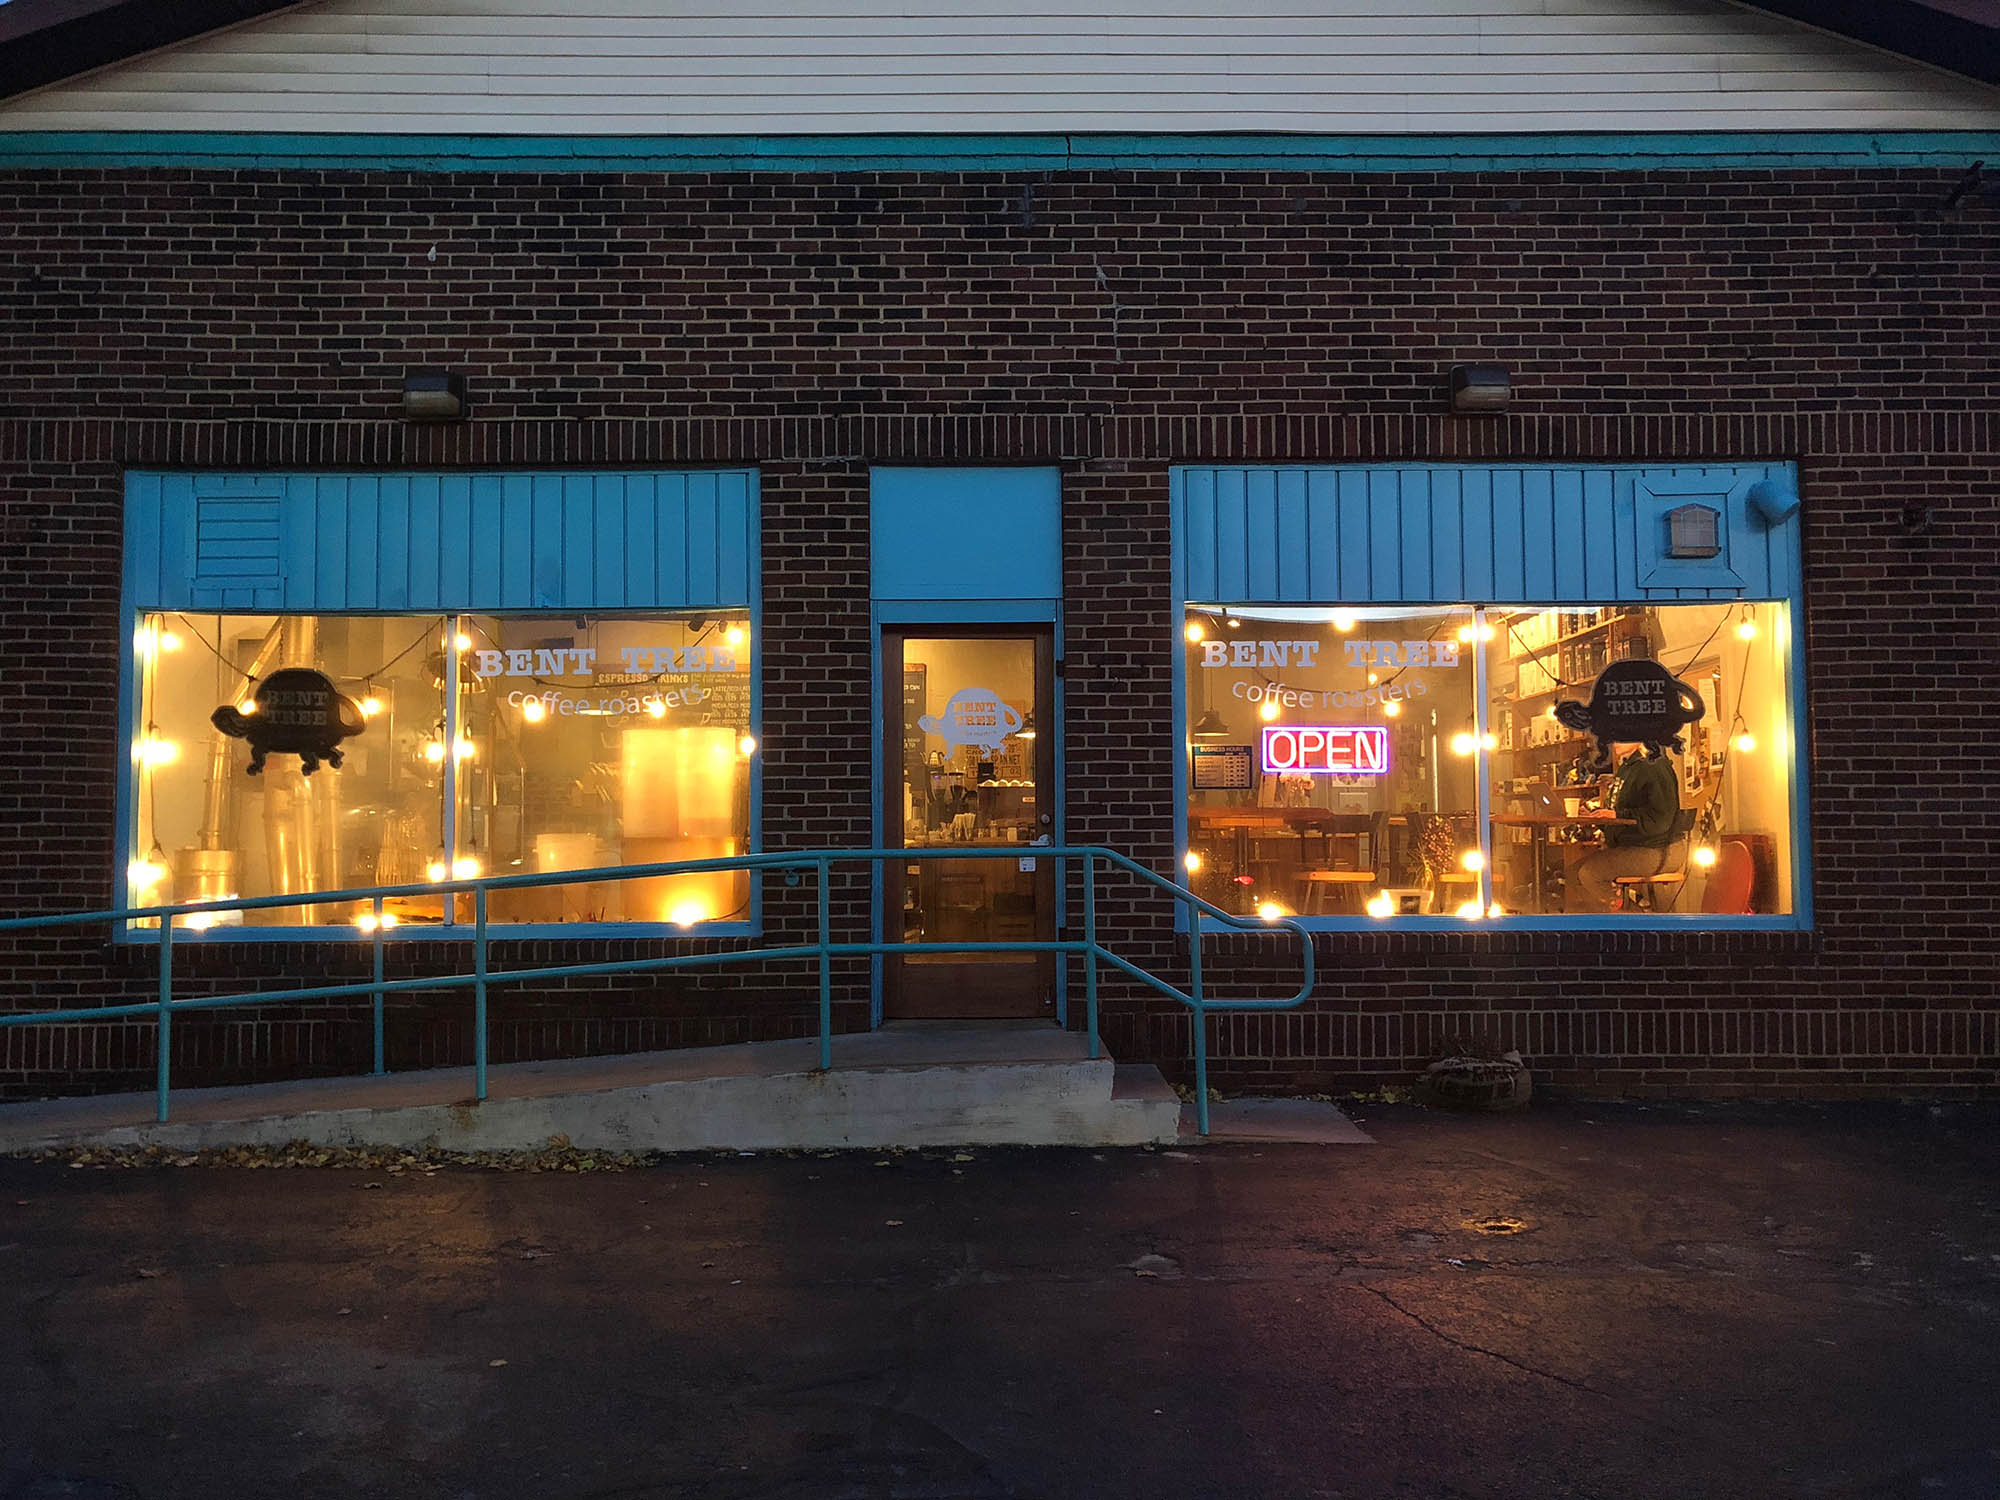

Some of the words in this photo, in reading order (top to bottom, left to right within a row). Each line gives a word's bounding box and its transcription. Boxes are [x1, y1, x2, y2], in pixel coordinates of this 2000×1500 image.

[475, 648, 596, 677] BENT
[621, 646, 736, 673] TREE
[1200, 640, 1319, 668] BENT
[1344, 640, 1459, 668] TREE
[598, 673, 649, 684] ESPRESSO
[1232, 680, 1314, 709] coffee
[1322, 678, 1427, 708] roasters
[1603, 679, 1666, 696] BENT
[265, 689, 329, 706] BENT
[507, 689, 589, 717] coffee
[599, 683, 705, 715] roasters
[951, 701, 997, 713] BENT
[1607, 699, 1667, 715] TREE
[266, 709, 328, 726] TREE
[953, 714, 997, 726] TREE
[1268, 730, 1383, 770] OPEN
